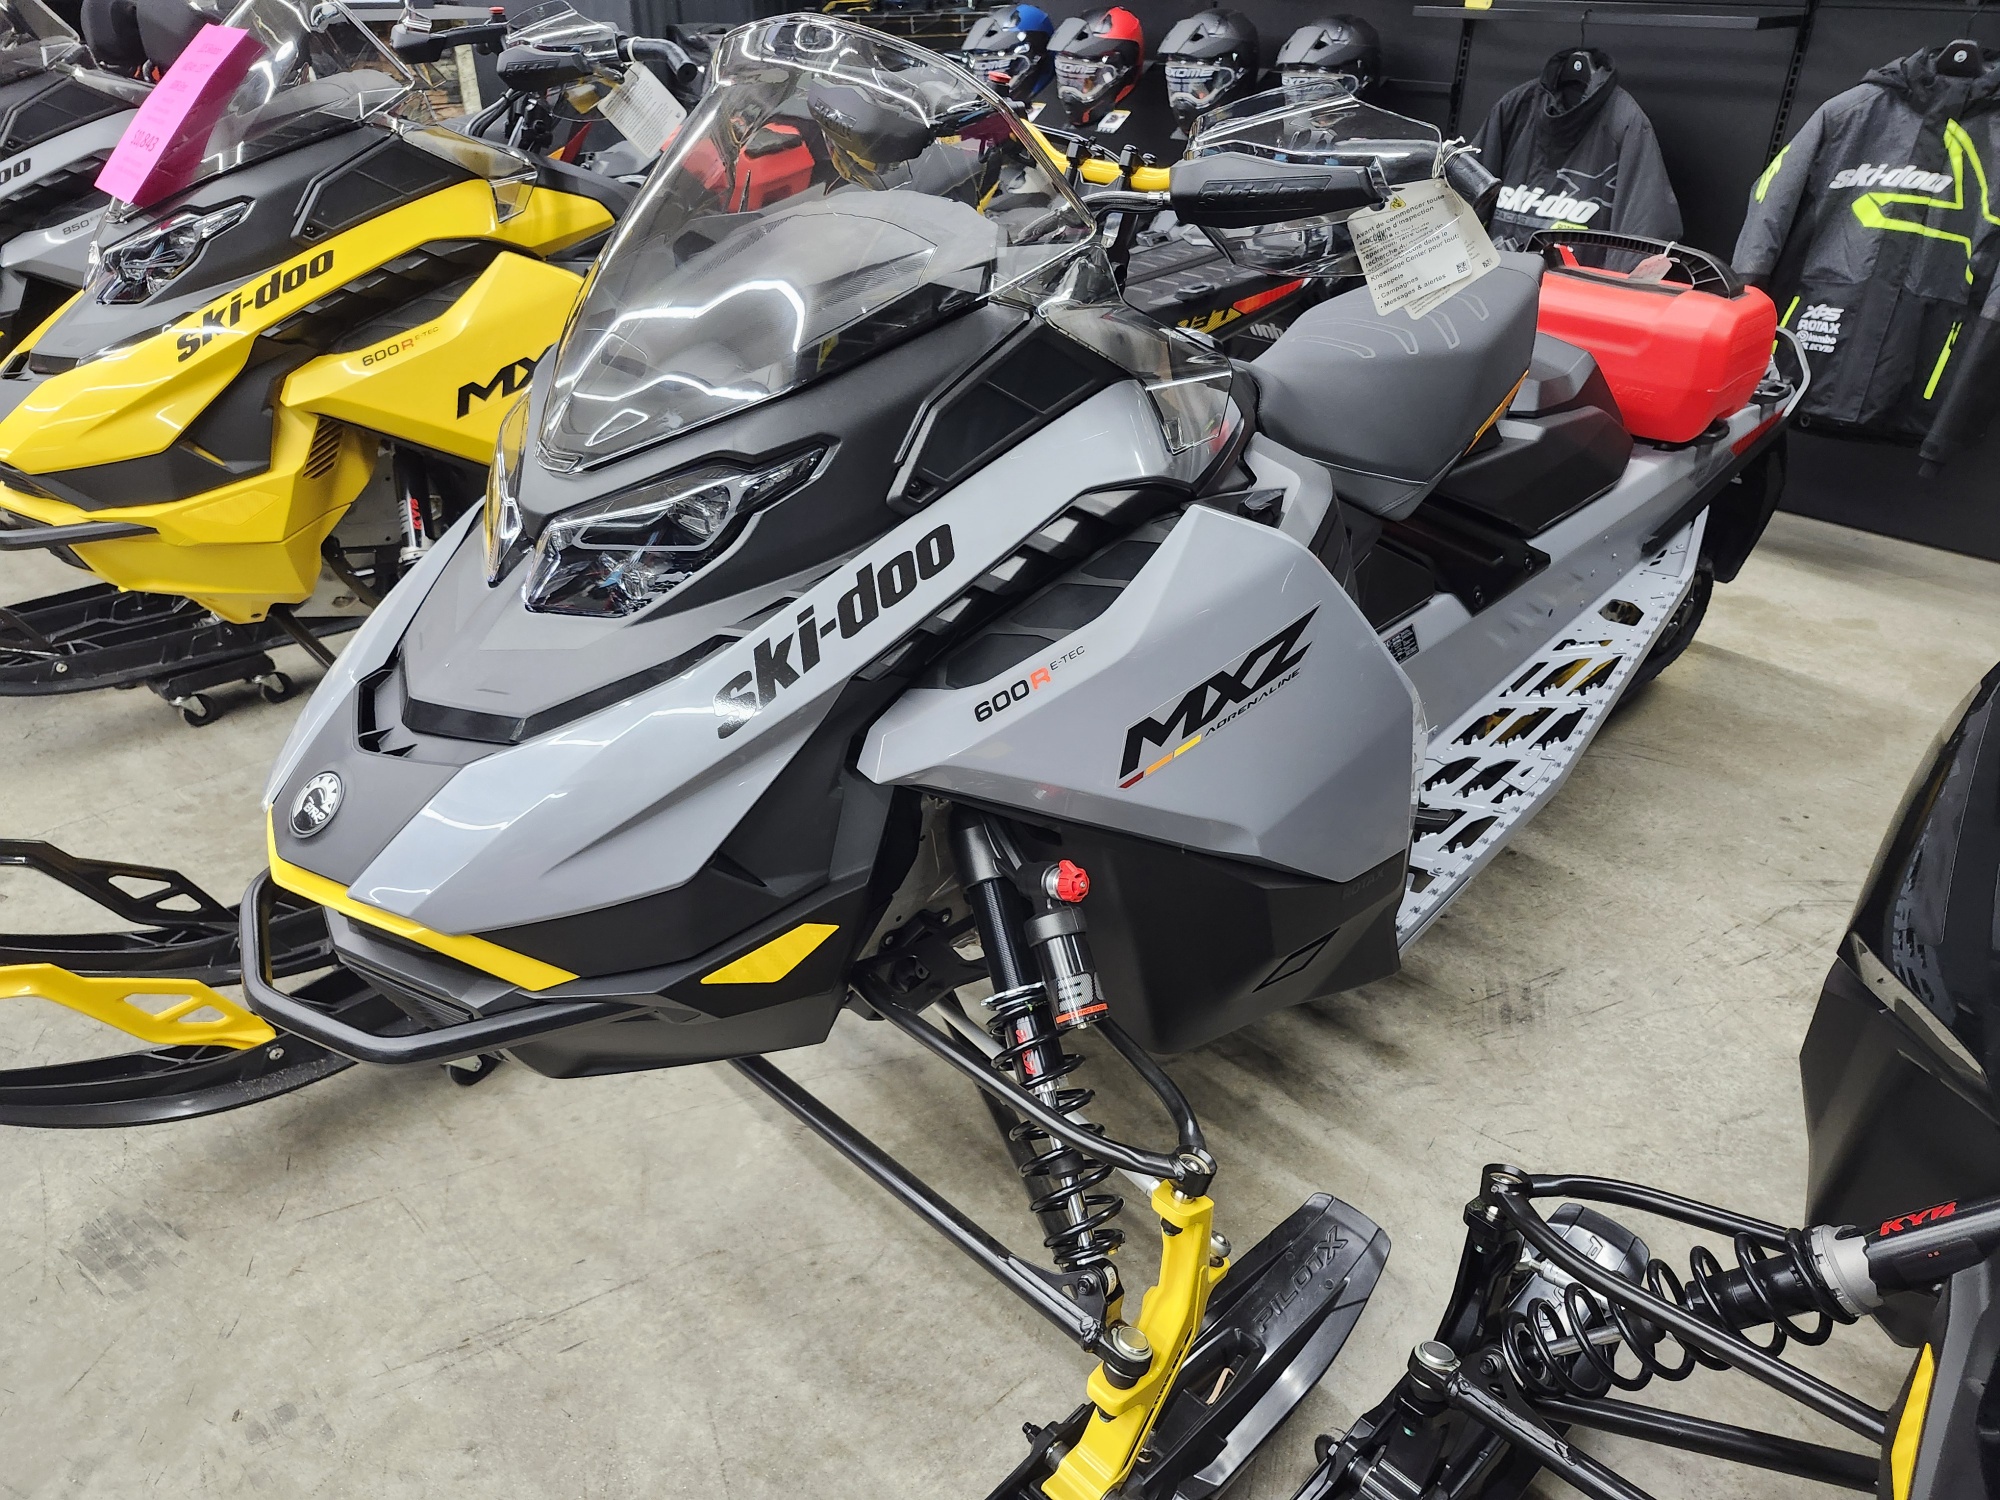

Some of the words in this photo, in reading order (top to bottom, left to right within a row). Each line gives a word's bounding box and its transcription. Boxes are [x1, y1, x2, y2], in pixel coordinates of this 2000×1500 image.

[1829, 163, 1953, 193] ski-doo
[1496, 184, 1600, 223] ski-doo
[63, 220, 89, 235] 850
[1356, 225, 1376, 240] Avant
[1376, 220, 1384, 229] de
[1386, 202, 1425, 223] commencer
[1370, 260, 1405, 281] Knowledge
[1405, 249, 1427, 263] Center
[1378, 273, 1404, 290] Rappels
[1381, 277, 1419, 299] Campagnes
[1384, 289, 1416, 307] Messages
[1424, 274, 1447, 288] alertes
[176, 249, 334, 363] ski-doo
[1797, 319, 1841, 334] ROTAX
[456, 343, 555, 420] MX
[713, 524, 955, 739] ski-doo
[1049, 645, 1085, 671] E-TEC
[1119, 605, 1320, 779] MXZ
[1205, 668, 1301, 737] ADRENALINE
[303, 802, 326, 824] BRP
[1879, 1201, 1957, 1236] KYB
